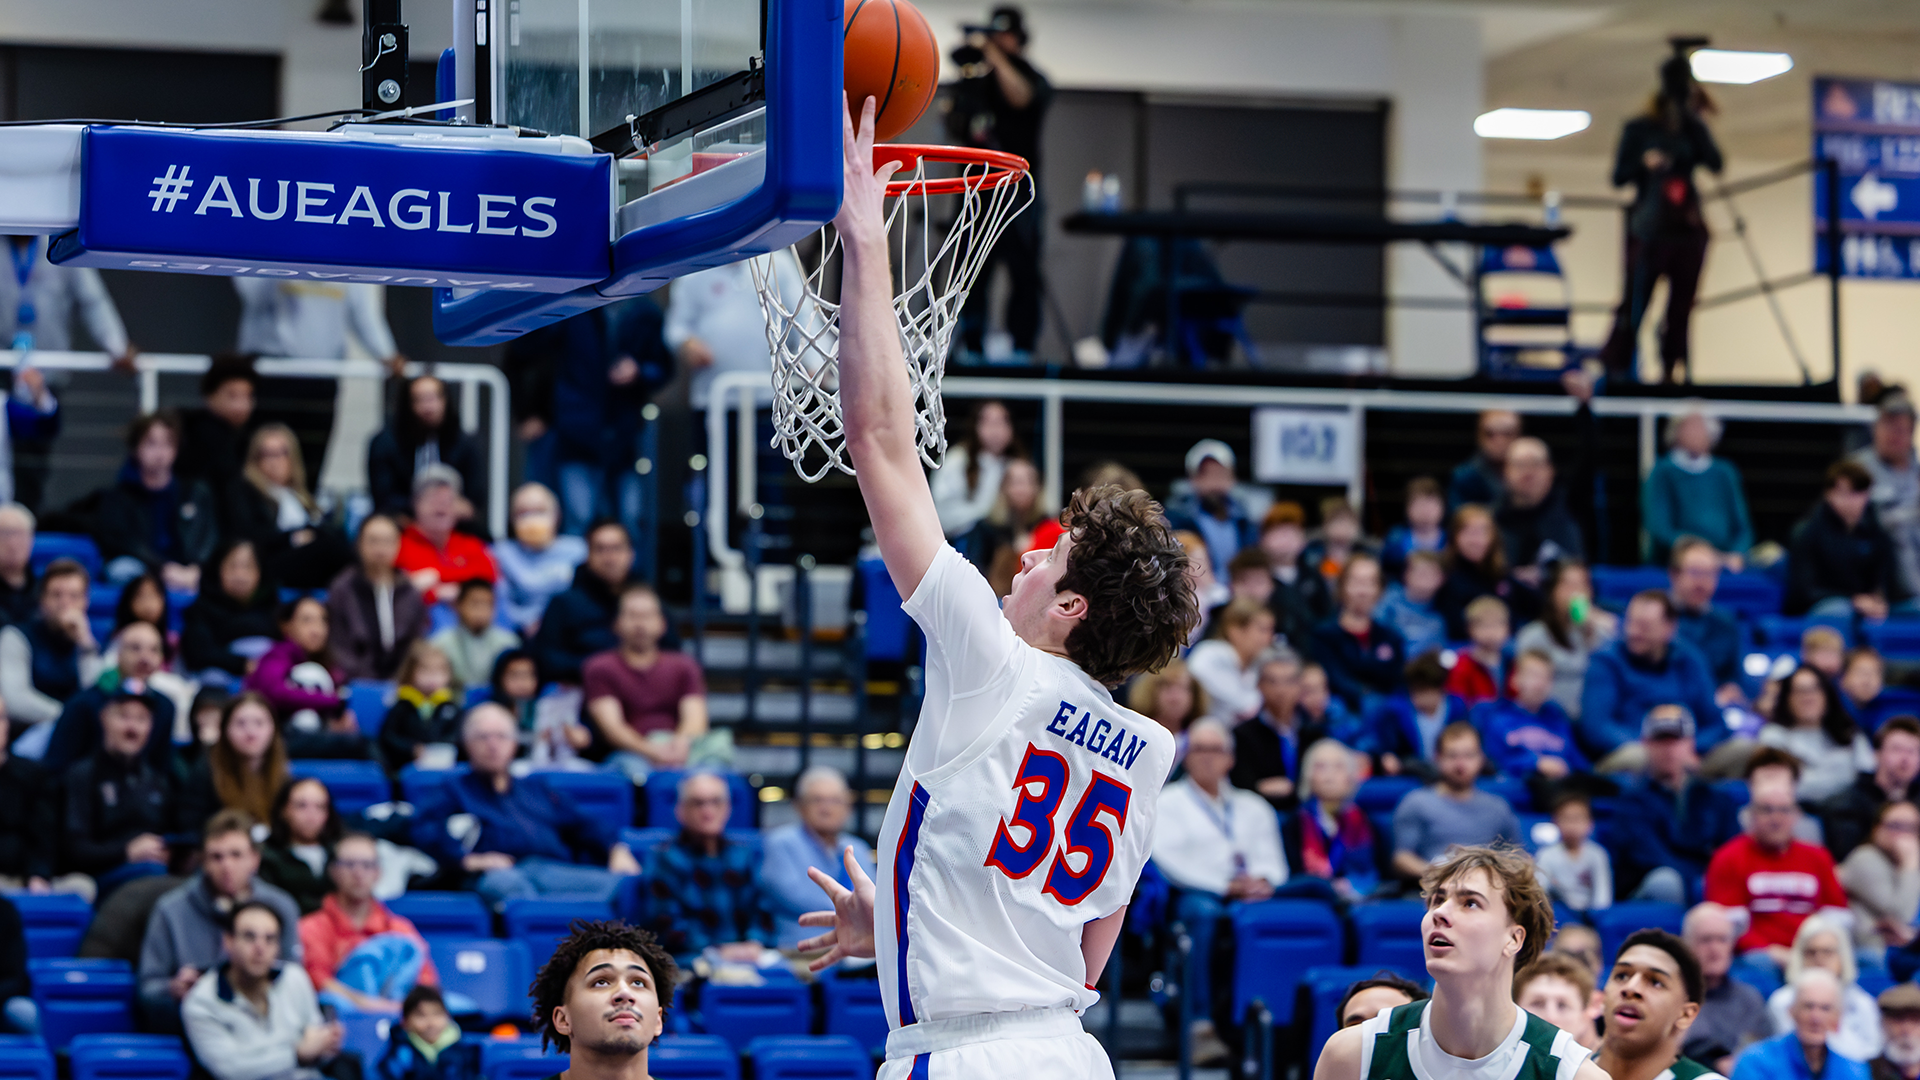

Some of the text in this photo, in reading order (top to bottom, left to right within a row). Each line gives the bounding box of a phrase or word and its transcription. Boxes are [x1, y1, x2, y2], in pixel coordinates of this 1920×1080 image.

[148, 164, 558, 239] #AUEAGLES
[127, 259, 537, 289] #AUEAGLES
[1046, 700, 1148, 771] EAGAN
[983, 741, 1133, 906] 35
